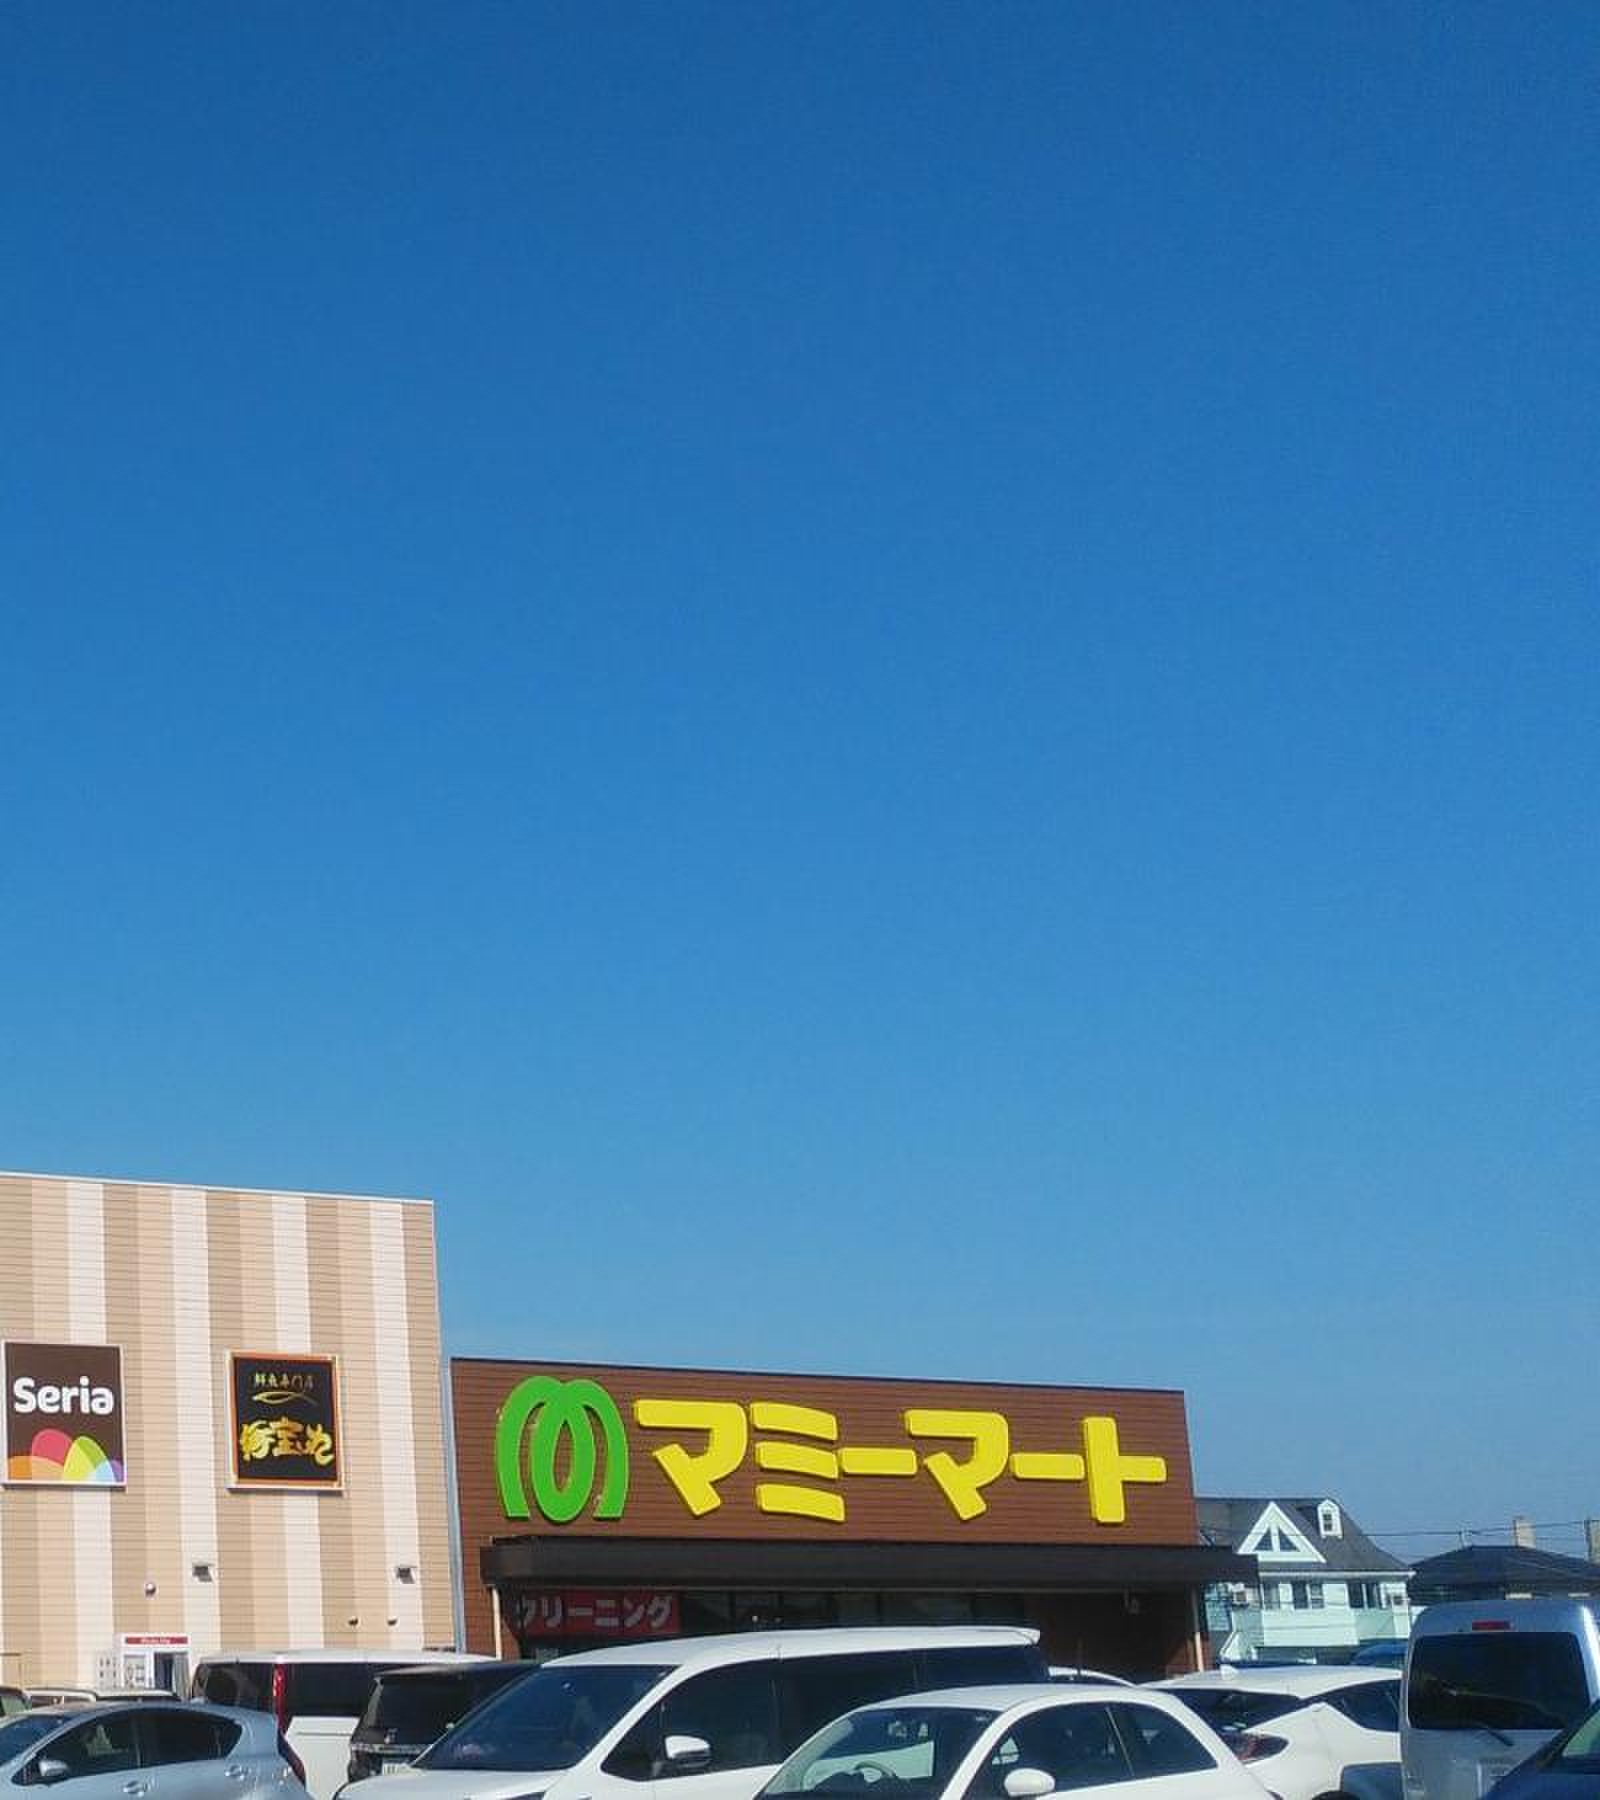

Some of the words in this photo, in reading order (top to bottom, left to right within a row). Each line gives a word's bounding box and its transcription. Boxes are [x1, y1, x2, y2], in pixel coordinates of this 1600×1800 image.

[12, 1375, 114, 1416] Seria
[634, 1398, 1167, 1524] マミーマート
[514, 1594, 674, 1629] クリーニング
